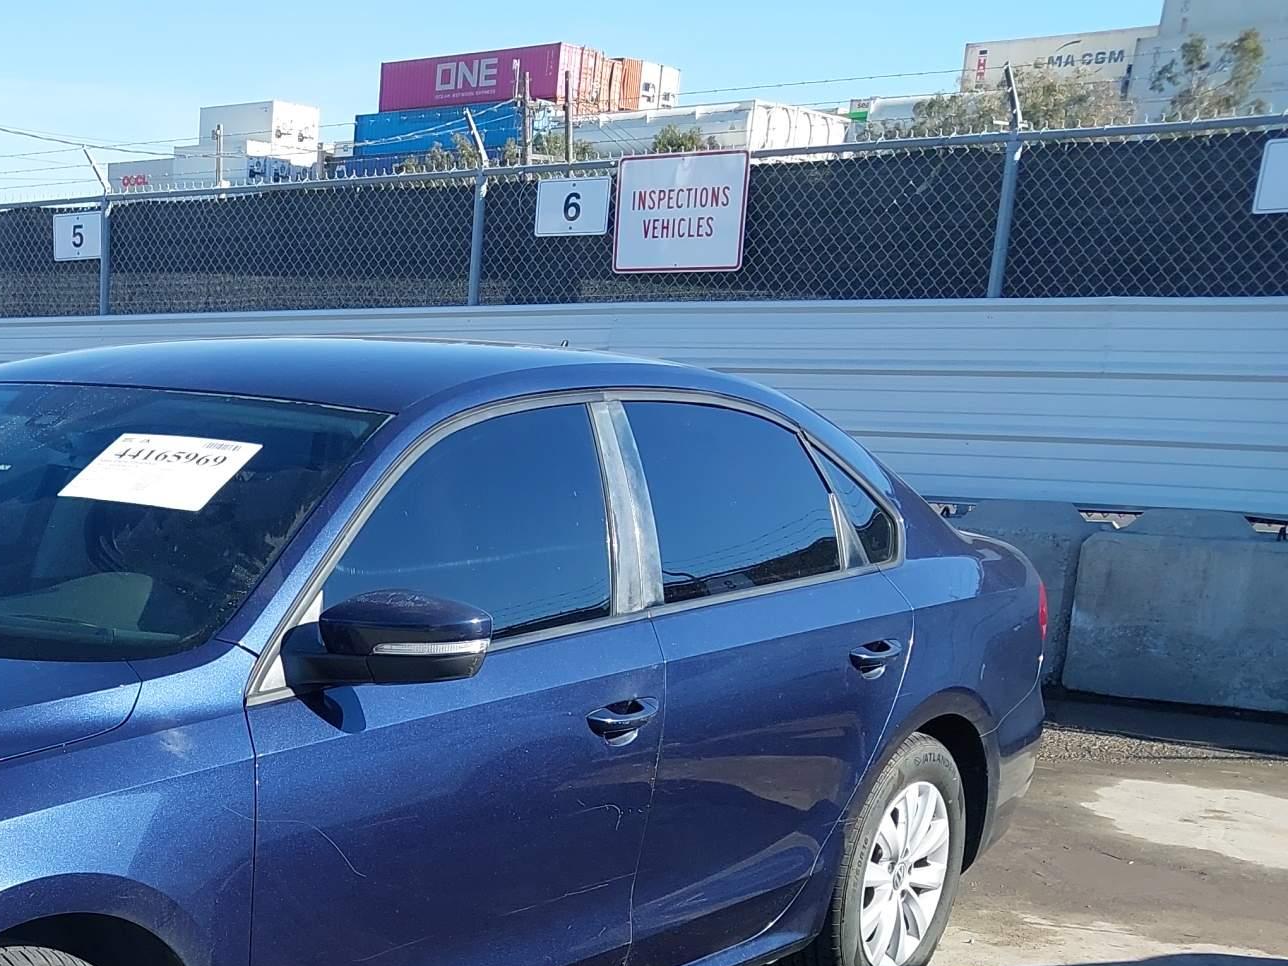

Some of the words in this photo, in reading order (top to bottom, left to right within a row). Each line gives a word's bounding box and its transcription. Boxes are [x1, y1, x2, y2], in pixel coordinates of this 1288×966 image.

[435, 58, 498, 91] ONE
[563, 192, 581, 222] 6
[632, 185, 731, 211] INSPECTIONS
[72, 224, 84, 248] 5
[643, 216, 714, 239] VEHICLES
[114, 447, 228, 468] 44165969
